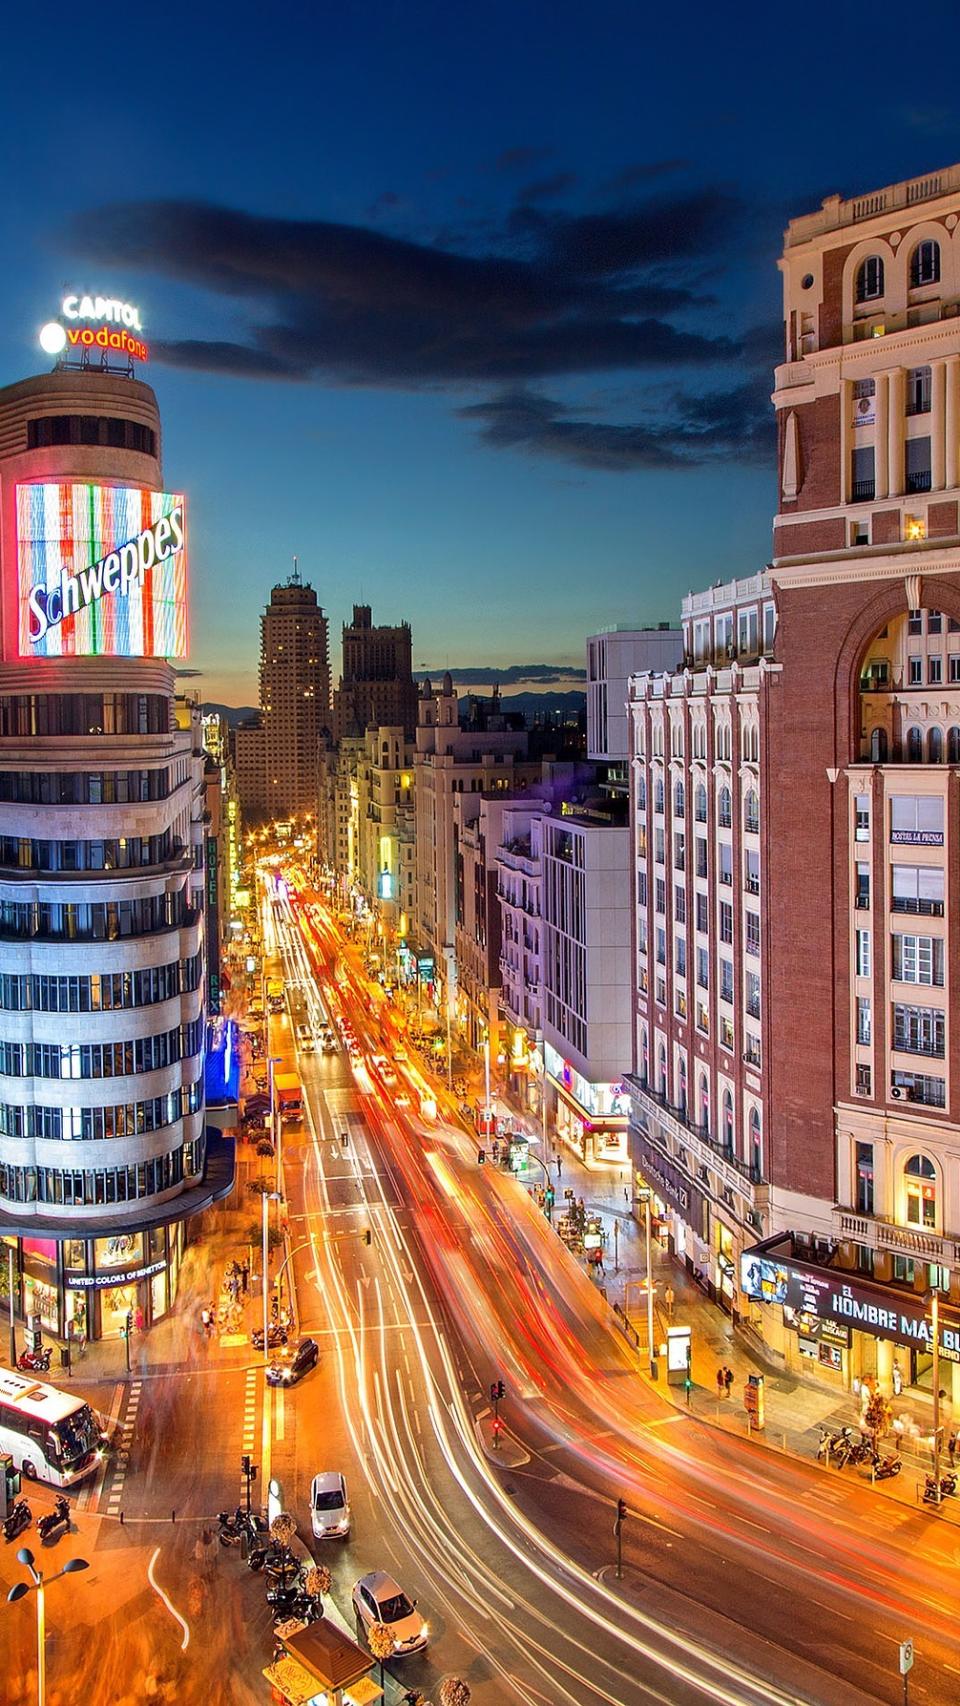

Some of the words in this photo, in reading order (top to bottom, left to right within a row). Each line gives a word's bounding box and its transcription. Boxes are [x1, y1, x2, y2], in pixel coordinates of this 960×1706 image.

[63, 295, 142, 331] CAPITOL
[67, 326, 147, 361] vodafone
[29, 503, 184, 644] Schweppes
[208, 842, 217, 904] HOTEL
[210, 974, 219, 1012] REX
[68, 1277, 94, 1286] UNITED
[95, 1274, 126, 1285] COLORS
[126, 1271, 137, 1280] OF
[136, 1260, 167, 1277] BENETTON
[842, 1285, 853, 1298] EL
[832, 1294, 897, 1331] HOMBRE
